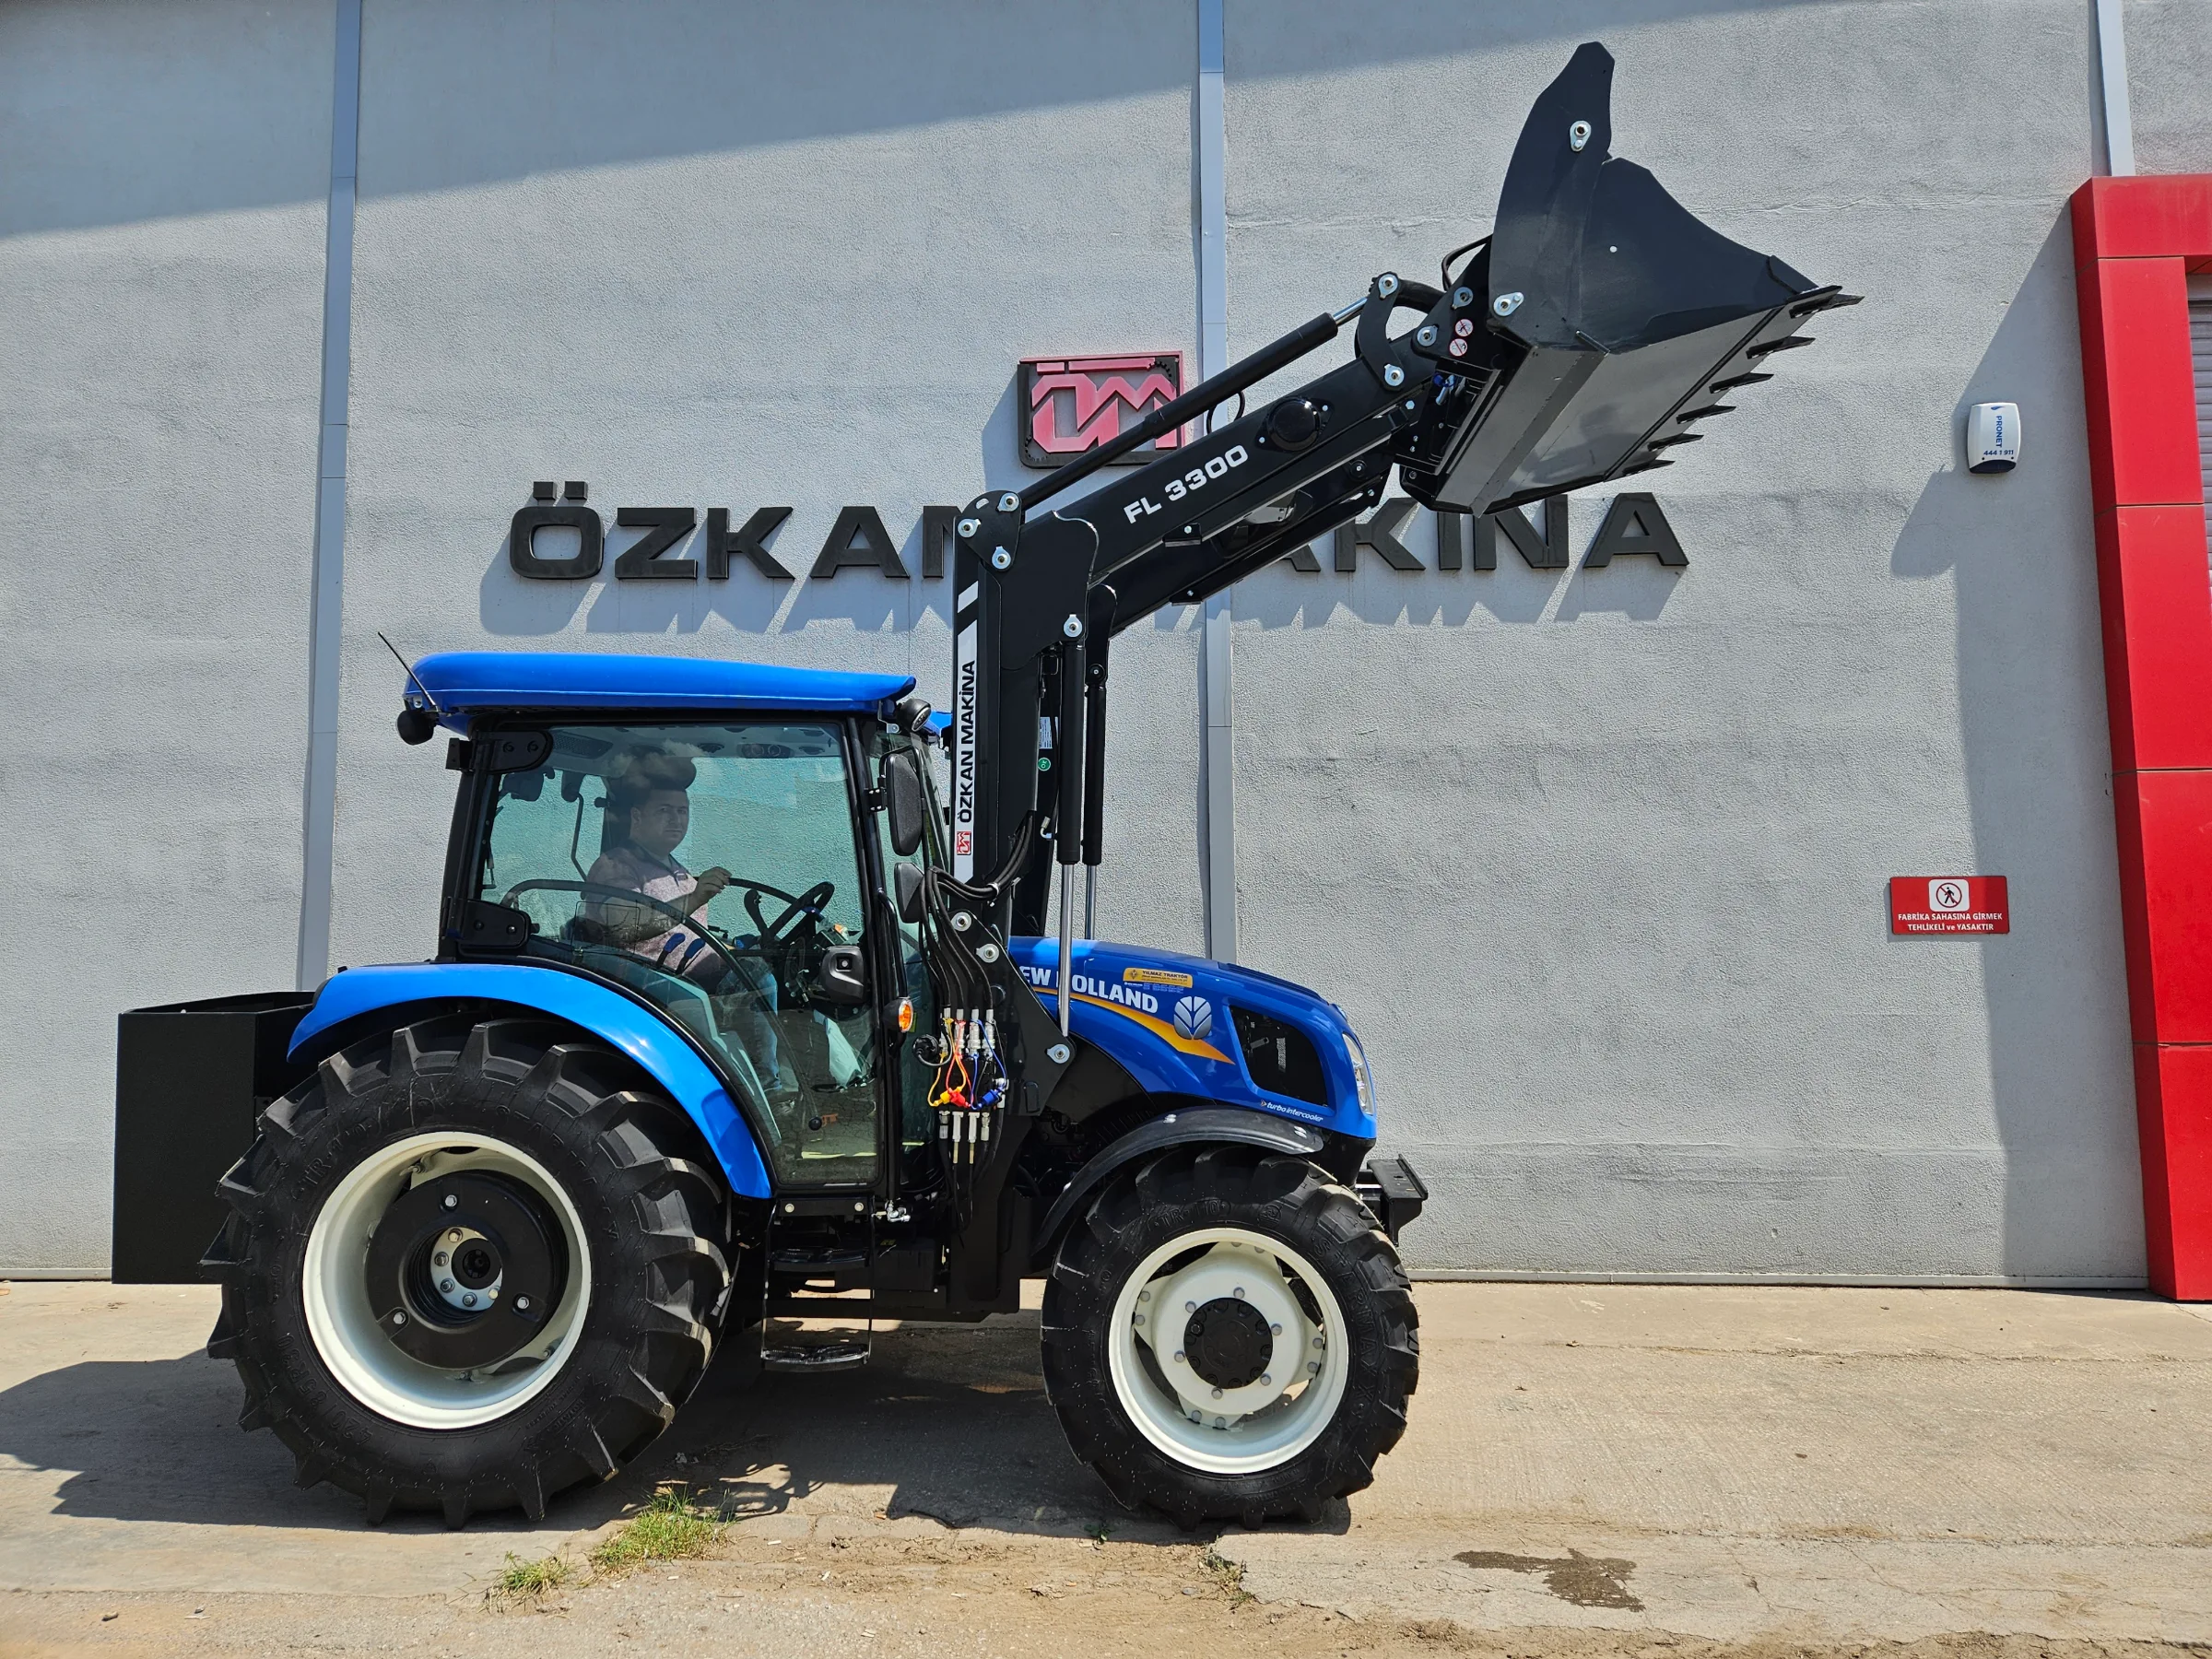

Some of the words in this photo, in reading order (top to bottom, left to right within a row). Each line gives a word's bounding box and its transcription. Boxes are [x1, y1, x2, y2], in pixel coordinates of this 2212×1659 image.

[1124, 496, 1162, 524] FL
[1164, 444, 1249, 501] 3300
[1278, 491, 1690, 572] KINA
[959, 660, 976, 745] MAKİNA
[957, 750, 973, 823] ÖZKAN
[1898, 912, 1929, 921] FABRİKA
[1932, 912, 1971, 921] SAHASINA
[1972, 912, 2003, 920] GİRMEK
[1908, 923, 1945, 931] TEHLİKELİ
[1018, 965, 1052, 986] EW
[1056, 970, 1159, 1014] OLLAND
[1266, 1101, 1287, 1112] turbo
[1286, 1106, 1324, 1123] intercooler
